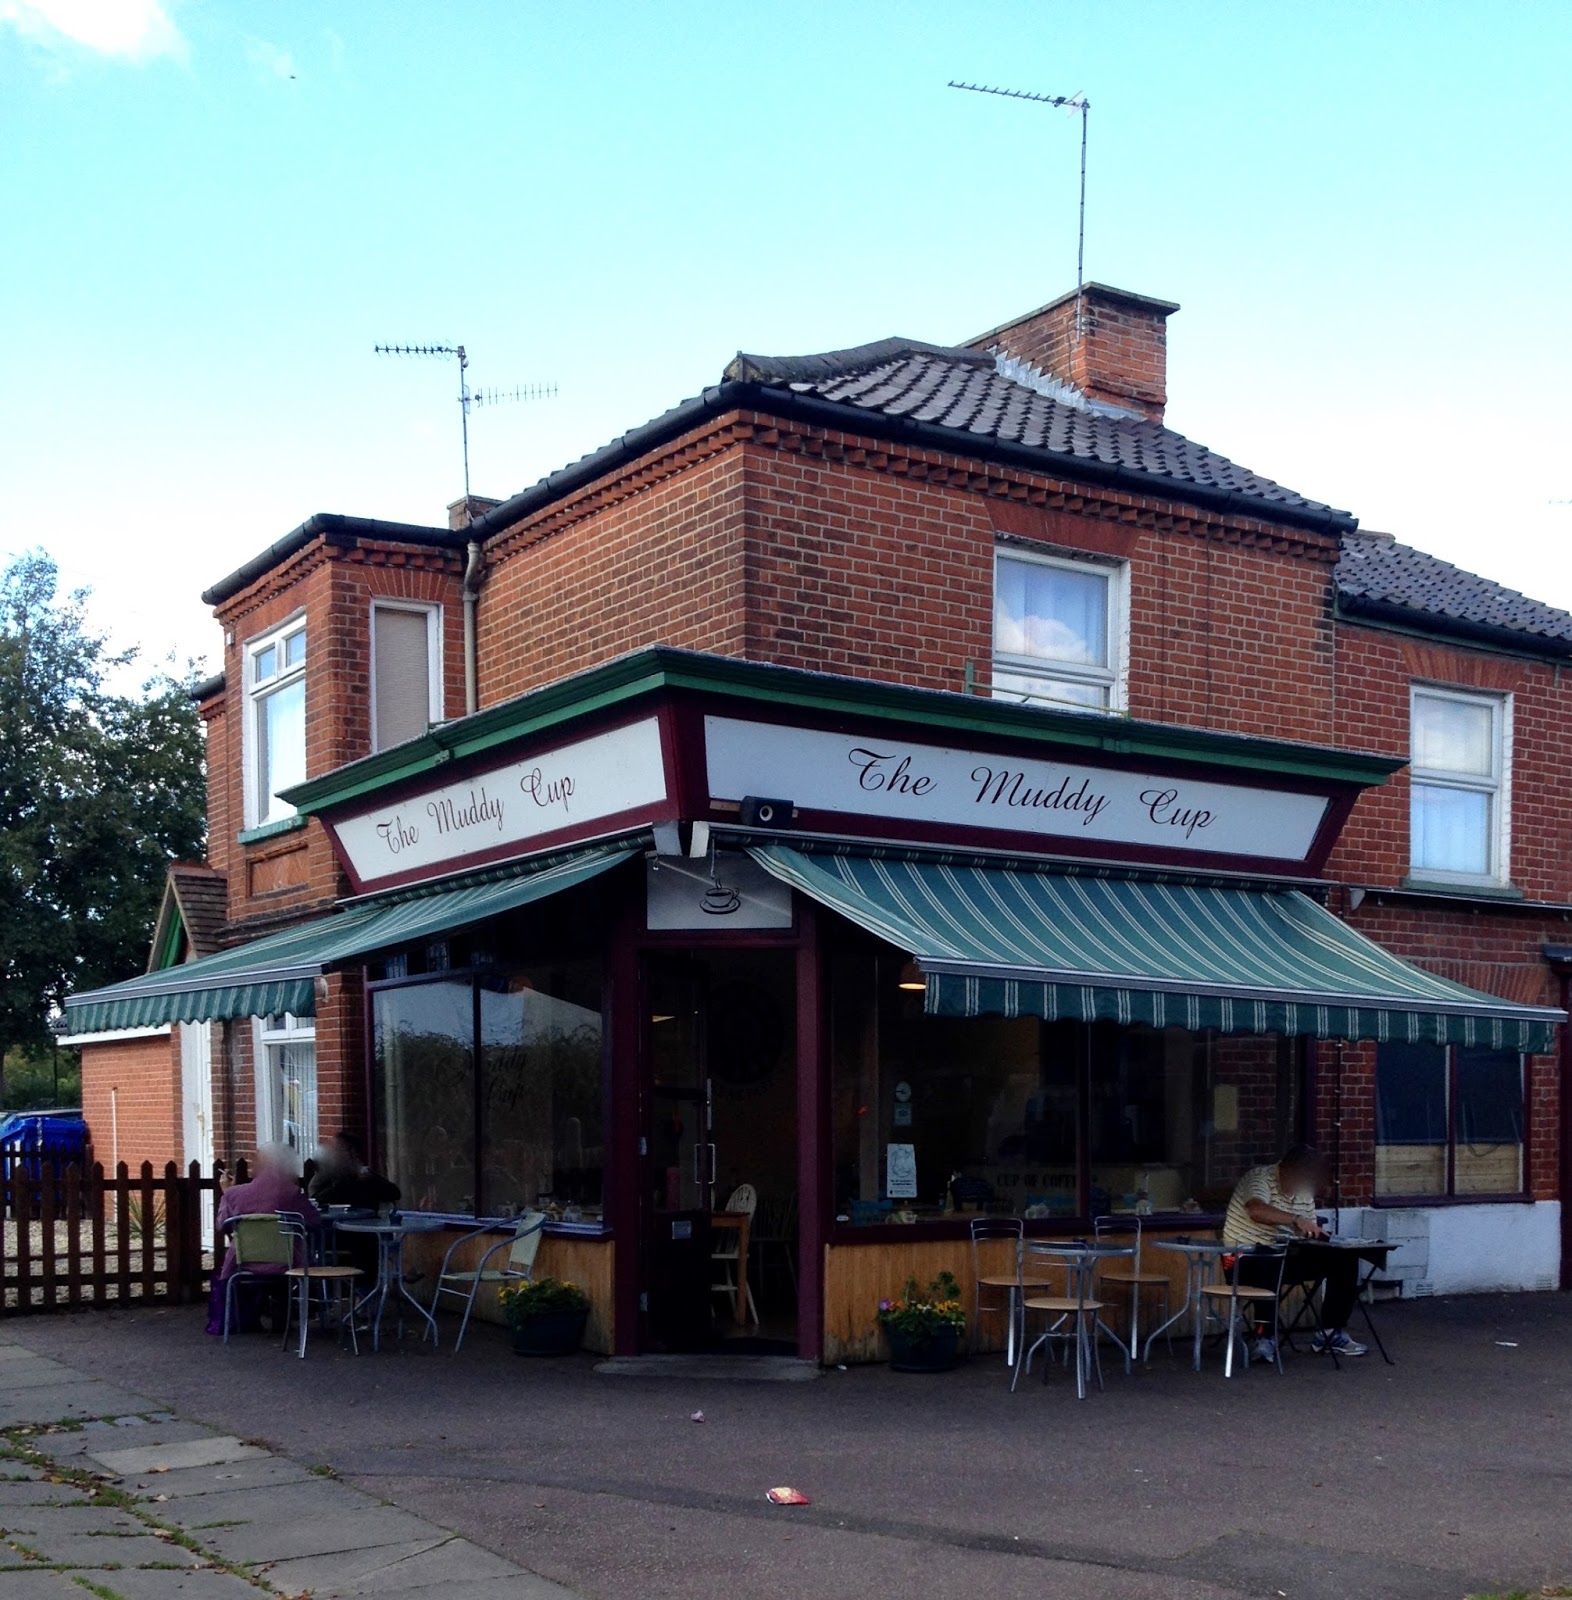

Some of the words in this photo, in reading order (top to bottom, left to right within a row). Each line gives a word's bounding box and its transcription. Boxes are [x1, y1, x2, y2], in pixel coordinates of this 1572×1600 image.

[376, 816, 420, 854] The
[427, 787, 505, 832] Muddy
[519, 767, 577, 812] Cup
[848, 747, 938, 796] The
[970, 766, 1112, 826] Muddy
[1139, 788, 1218, 840] Cup
[1042, 1173, 1077, 1189] COFF
